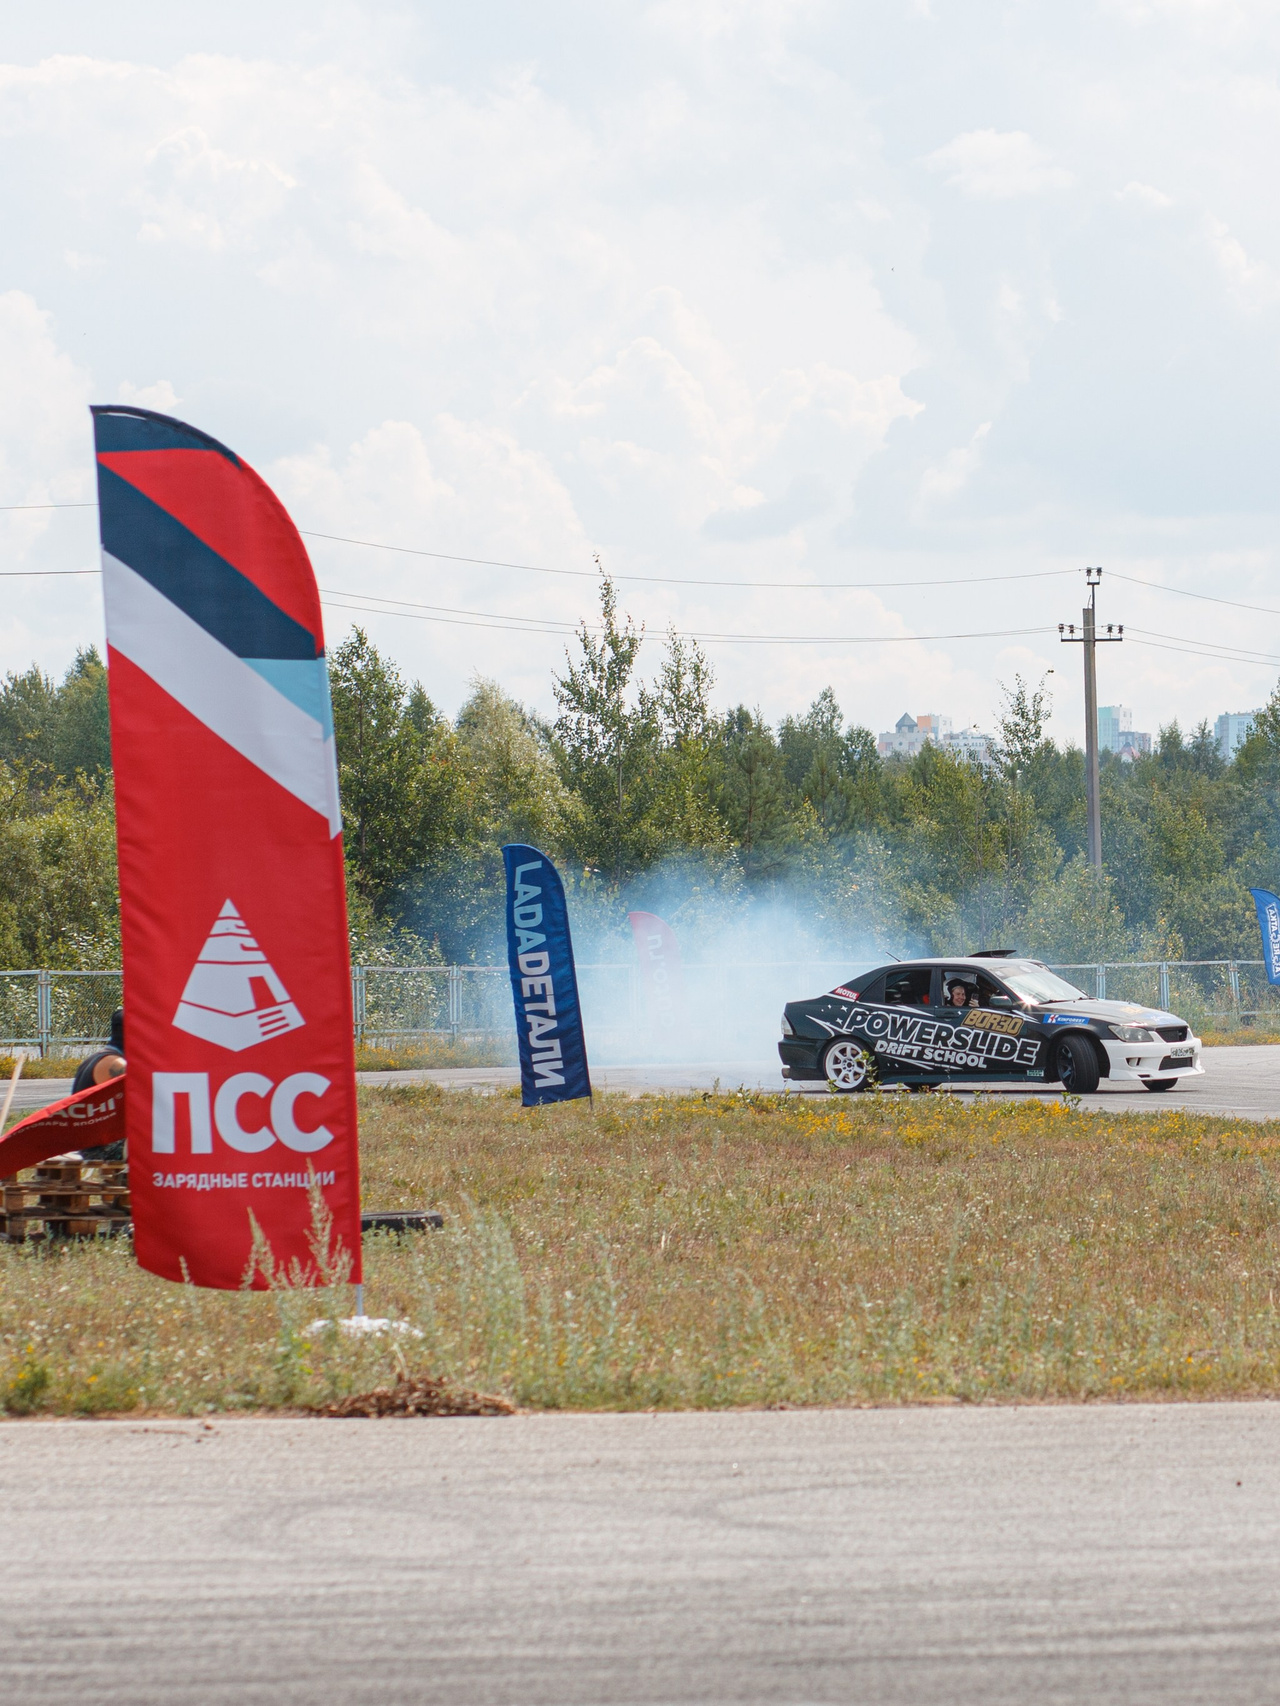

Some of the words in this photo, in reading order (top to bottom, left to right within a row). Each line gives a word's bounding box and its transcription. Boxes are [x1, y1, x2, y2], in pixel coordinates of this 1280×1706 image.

[835, 987, 858, 999] MOTUL
[843, 1007, 1041, 1066] POWERSLIDE
[874, 1040, 921, 1058] DRIFT
[923, 1047, 987, 1069] SCHOOL
[152, 1072, 335, 1154] ПСС
[152, 1172, 249, 1191] ЗАРЯДНЫЕ
[252, 1170, 336, 1190] СТАНЦИИ
